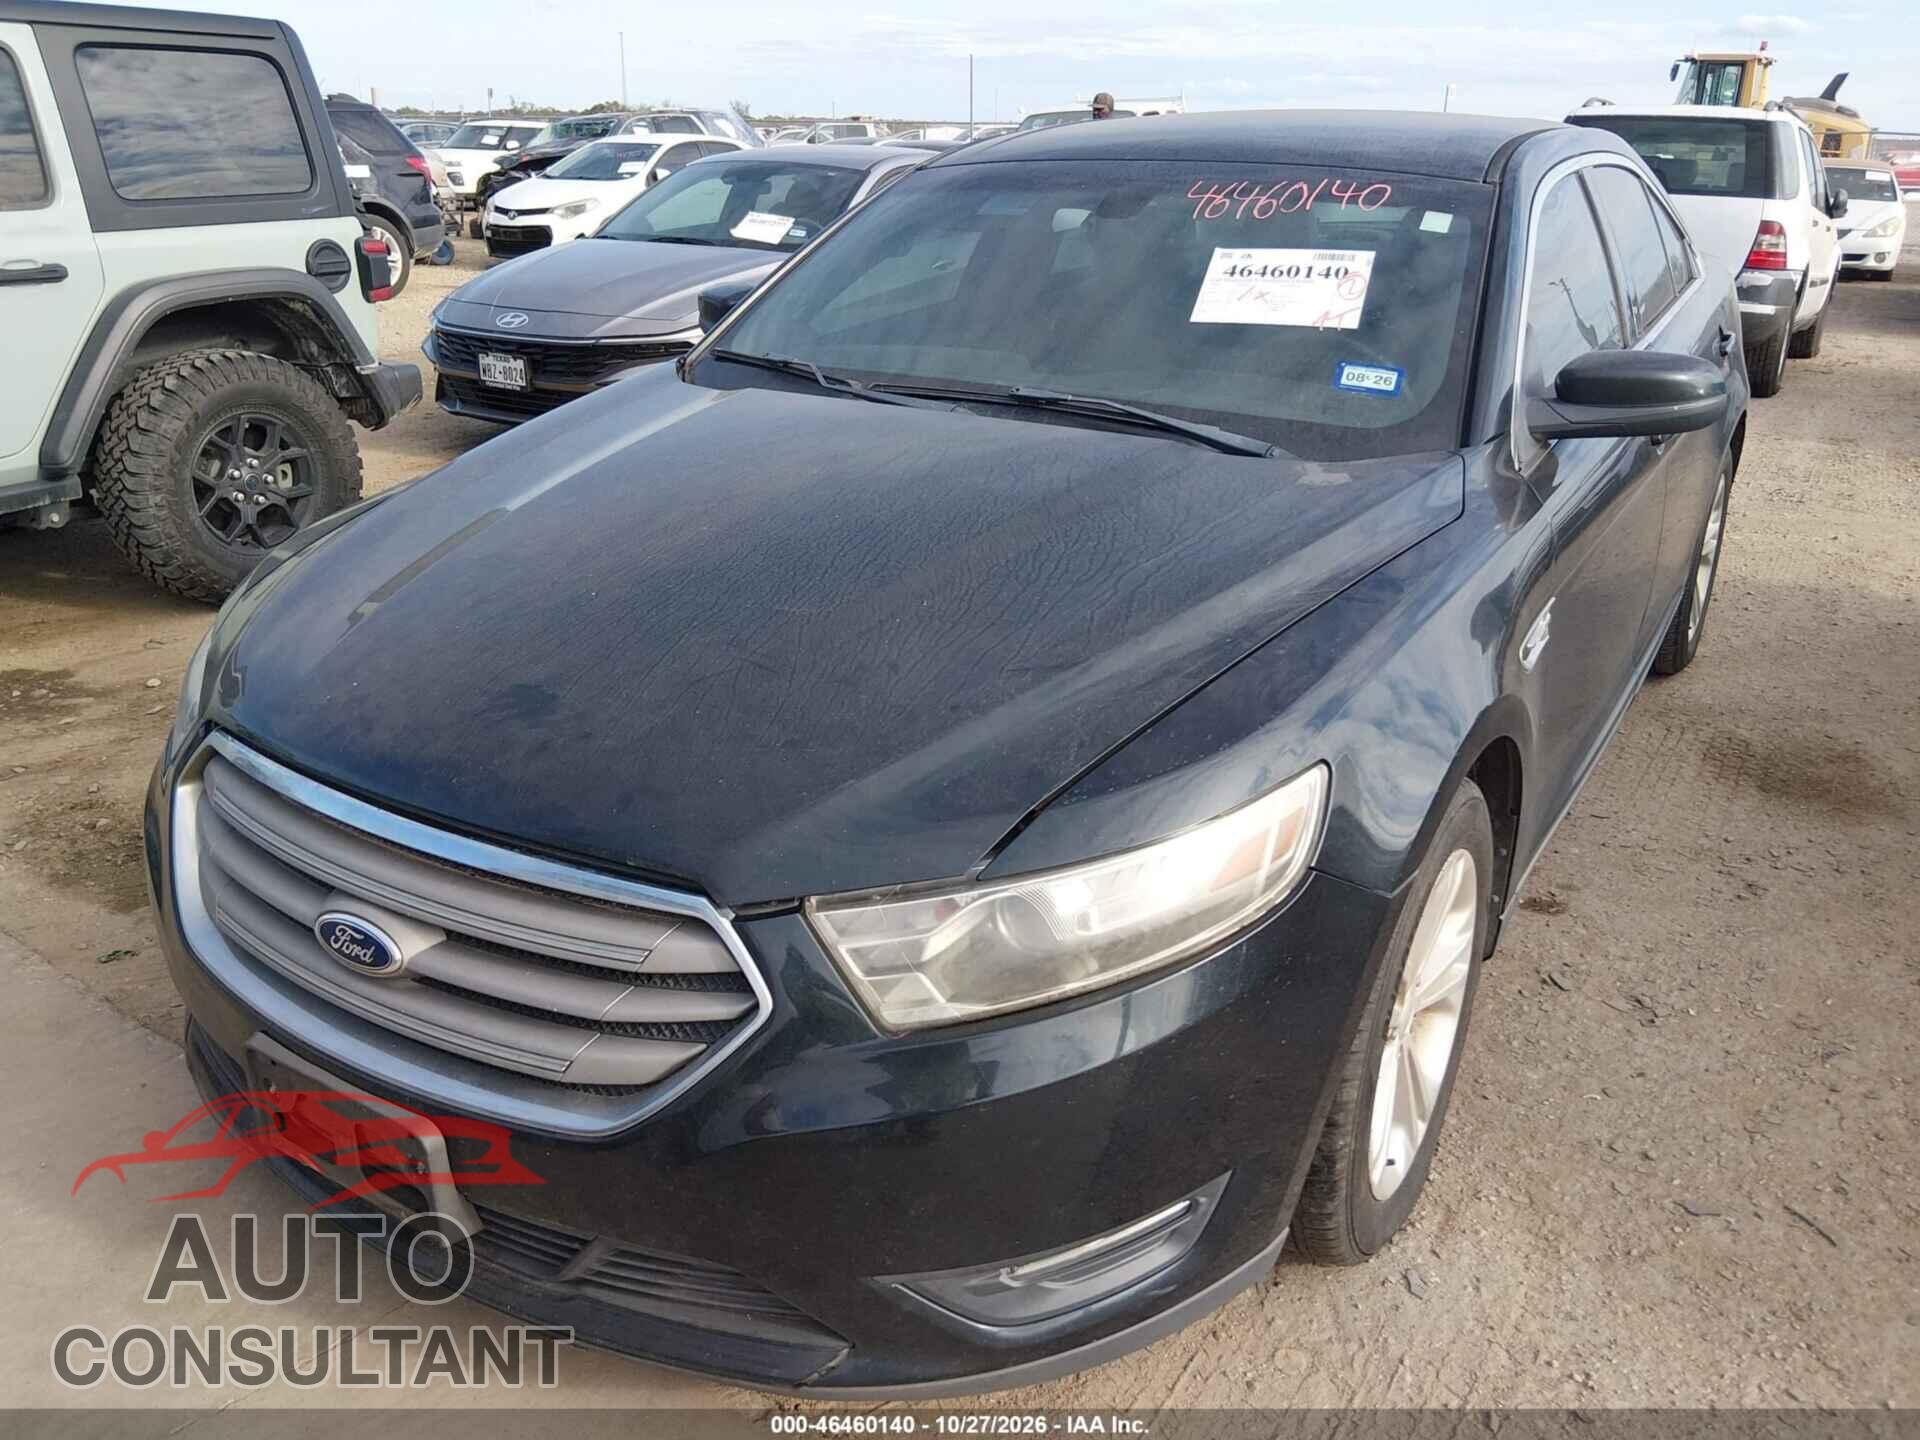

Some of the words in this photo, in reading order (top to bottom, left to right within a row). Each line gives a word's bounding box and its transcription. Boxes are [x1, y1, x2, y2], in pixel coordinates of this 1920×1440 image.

[1187, 178, 1392, 219] 46460140
[1223, 264, 1349, 280] 46460140
[330, 925, 376, 963] Ford
